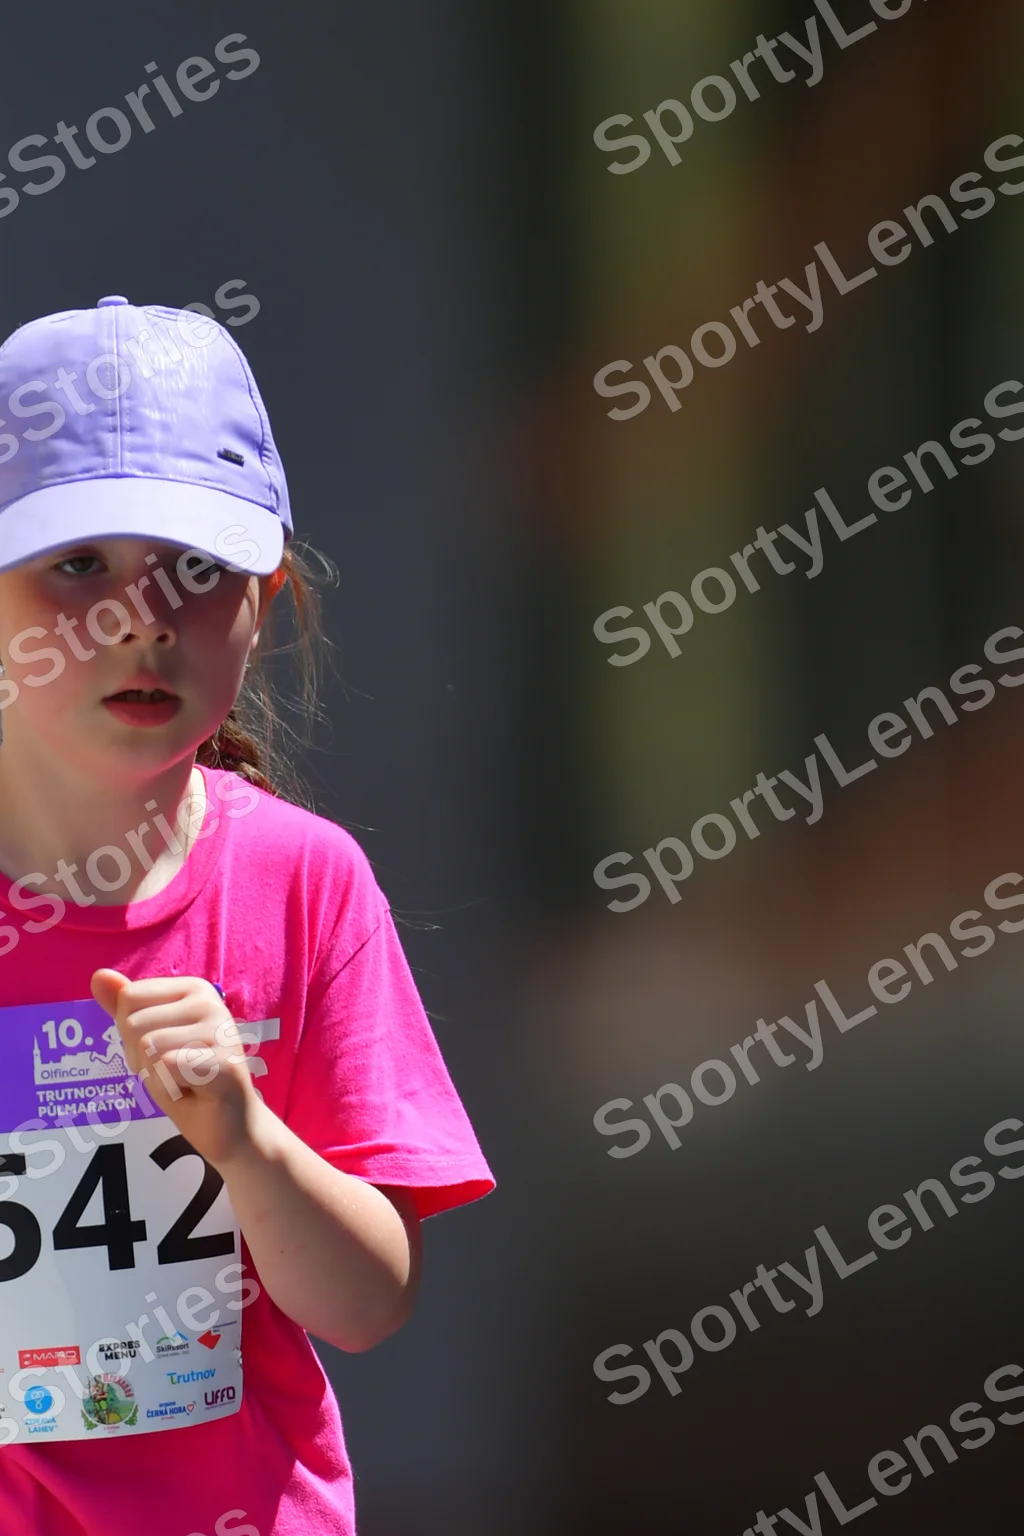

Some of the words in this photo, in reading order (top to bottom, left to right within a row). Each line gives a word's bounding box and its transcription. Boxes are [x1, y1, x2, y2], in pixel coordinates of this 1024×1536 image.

[42, 1019, 93, 1049] 10.
[41, 1067, 90, 1080] OlfinCar
[36, 1080, 135, 1103] TRUTNOVSKÝ
[98, 1340, 141, 1352] EXPRES
[104, 1350, 137, 1361] MENU
[167, 1368, 216, 1385] Trutnov
